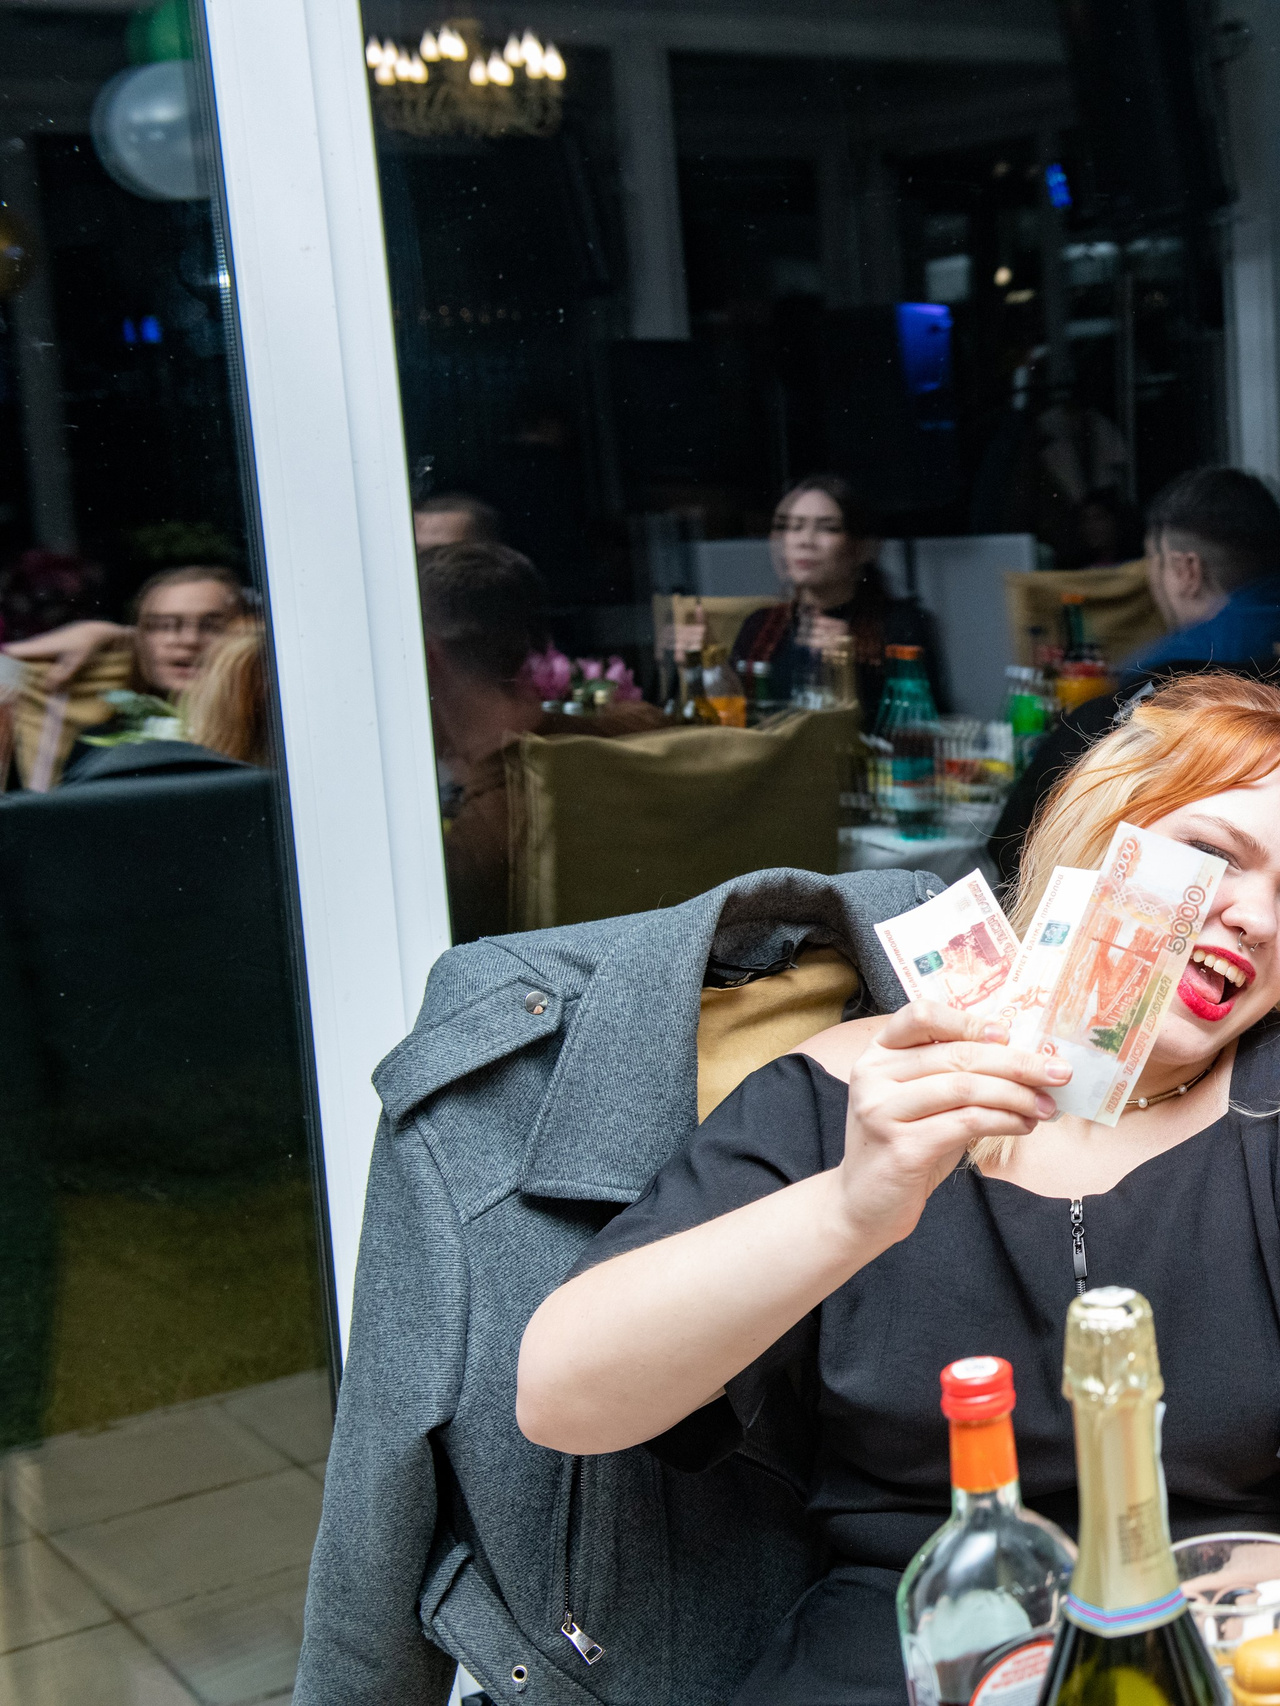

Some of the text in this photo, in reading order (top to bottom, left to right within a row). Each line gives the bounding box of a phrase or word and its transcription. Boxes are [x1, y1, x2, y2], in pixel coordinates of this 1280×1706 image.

[1112, 839, 1139, 881] 5000
[882, 928, 905, 965] ПРИКОЛОВ
[1011, 873, 1064, 982] БИЛЕТ БАНКА ПРИКОЛОВ
[1165, 885, 1206, 956] 5000
[1105, 1078, 1127, 1114] ПЯТЬ
[1123, 1030, 1150, 1076] ТЫСЯЧ
